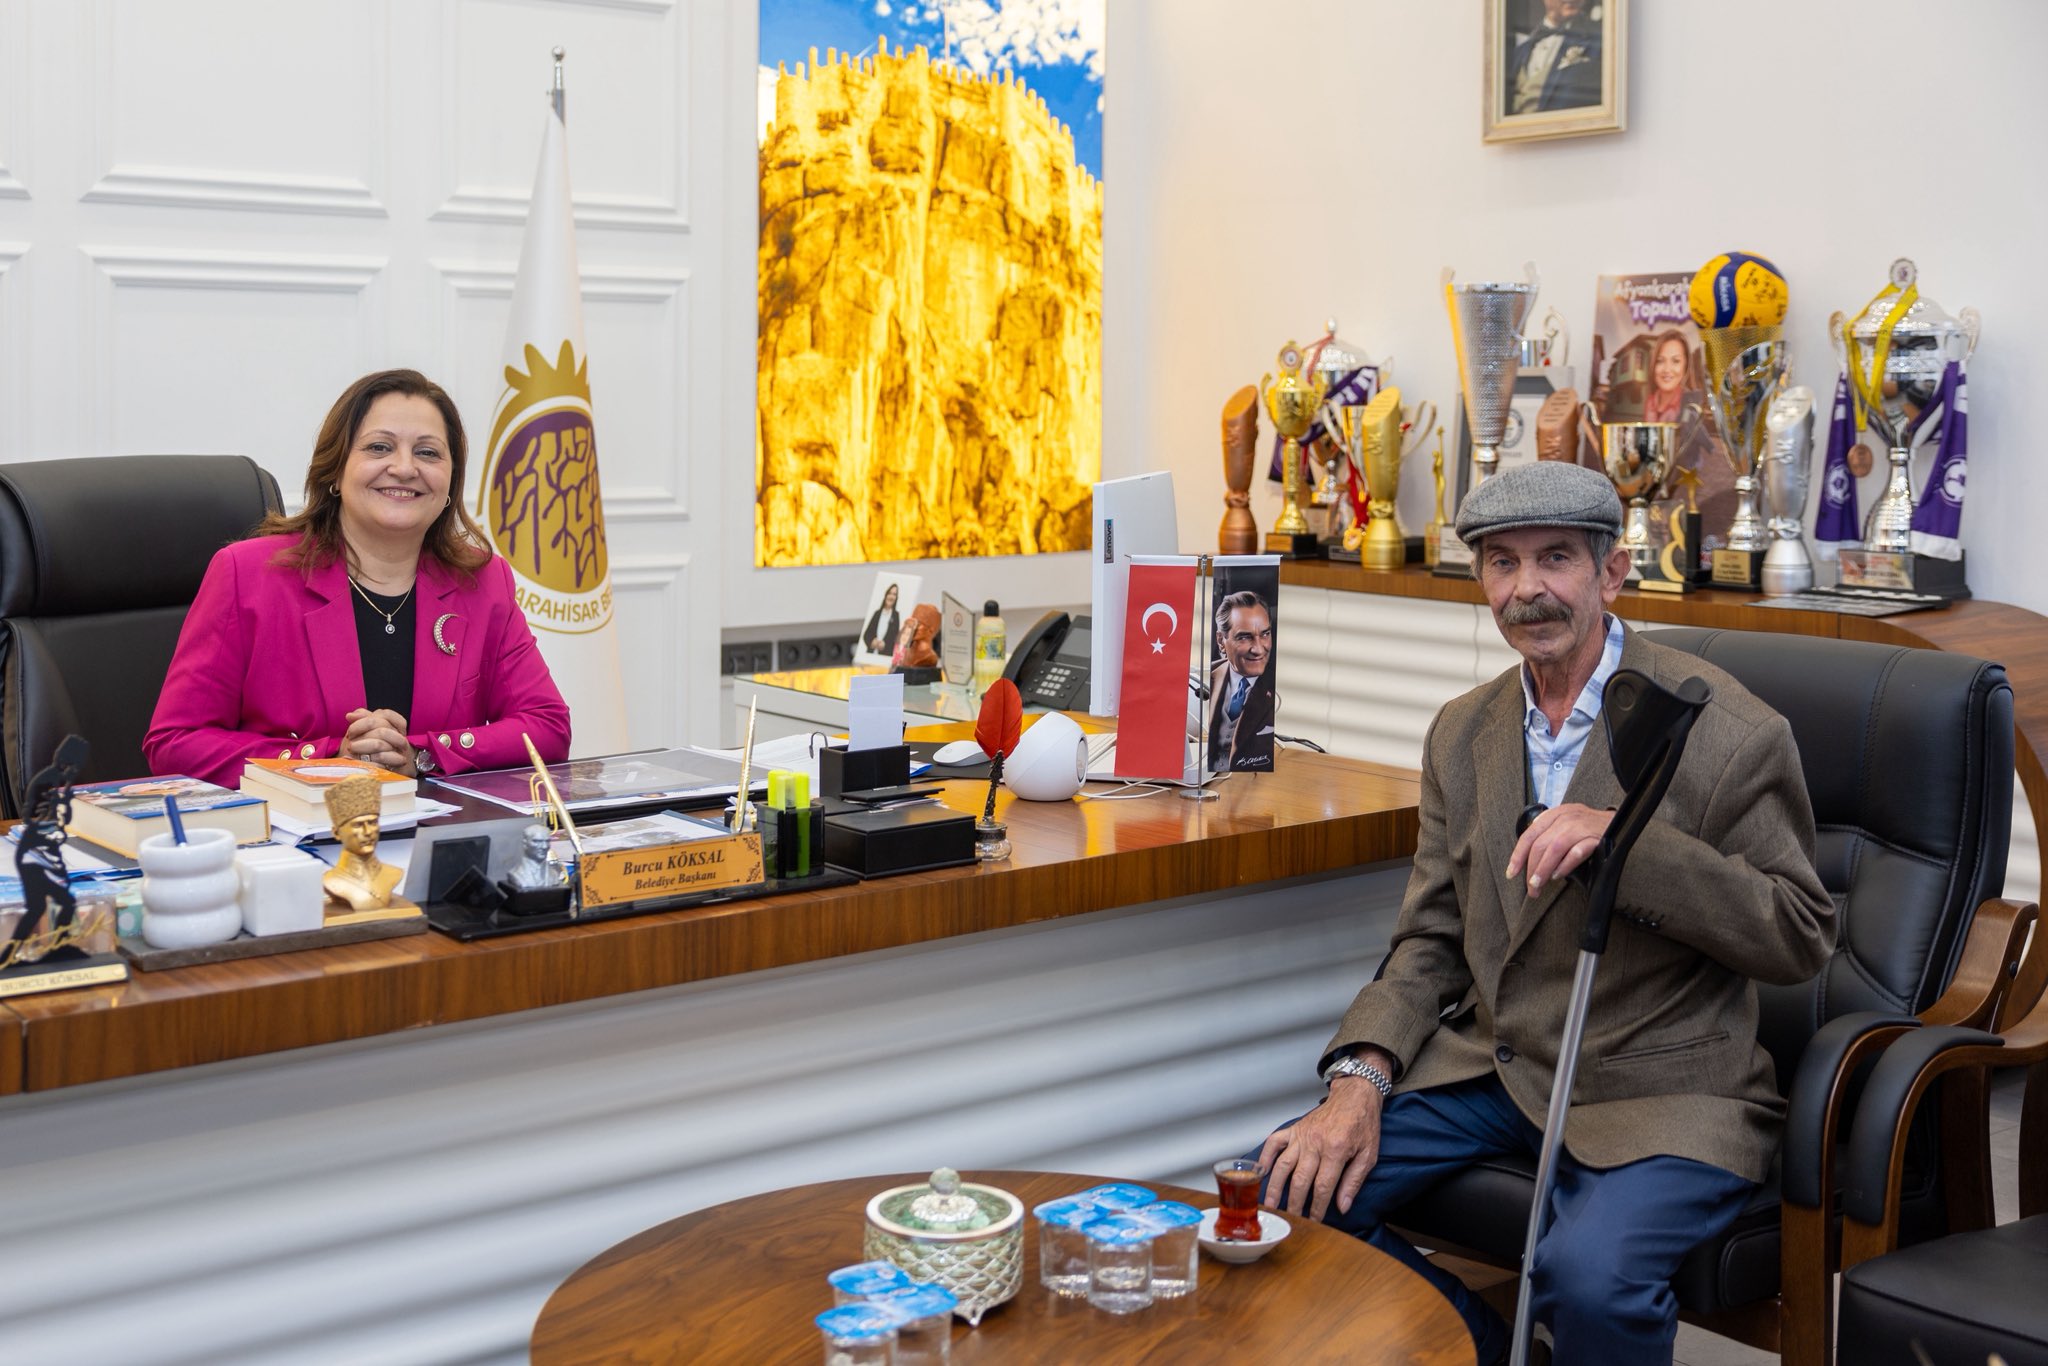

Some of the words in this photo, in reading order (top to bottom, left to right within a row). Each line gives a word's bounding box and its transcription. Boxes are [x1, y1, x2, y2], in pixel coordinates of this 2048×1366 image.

[1630, 293, 1690, 325] Topukl
[516, 586, 600, 622] ARAHİSAR
[623, 861, 663, 875] Burcu
[667, 849, 725, 870] KÖKSAL
[635, 875, 676, 889] Belediye
[678, 871, 716, 884] Başkanı
